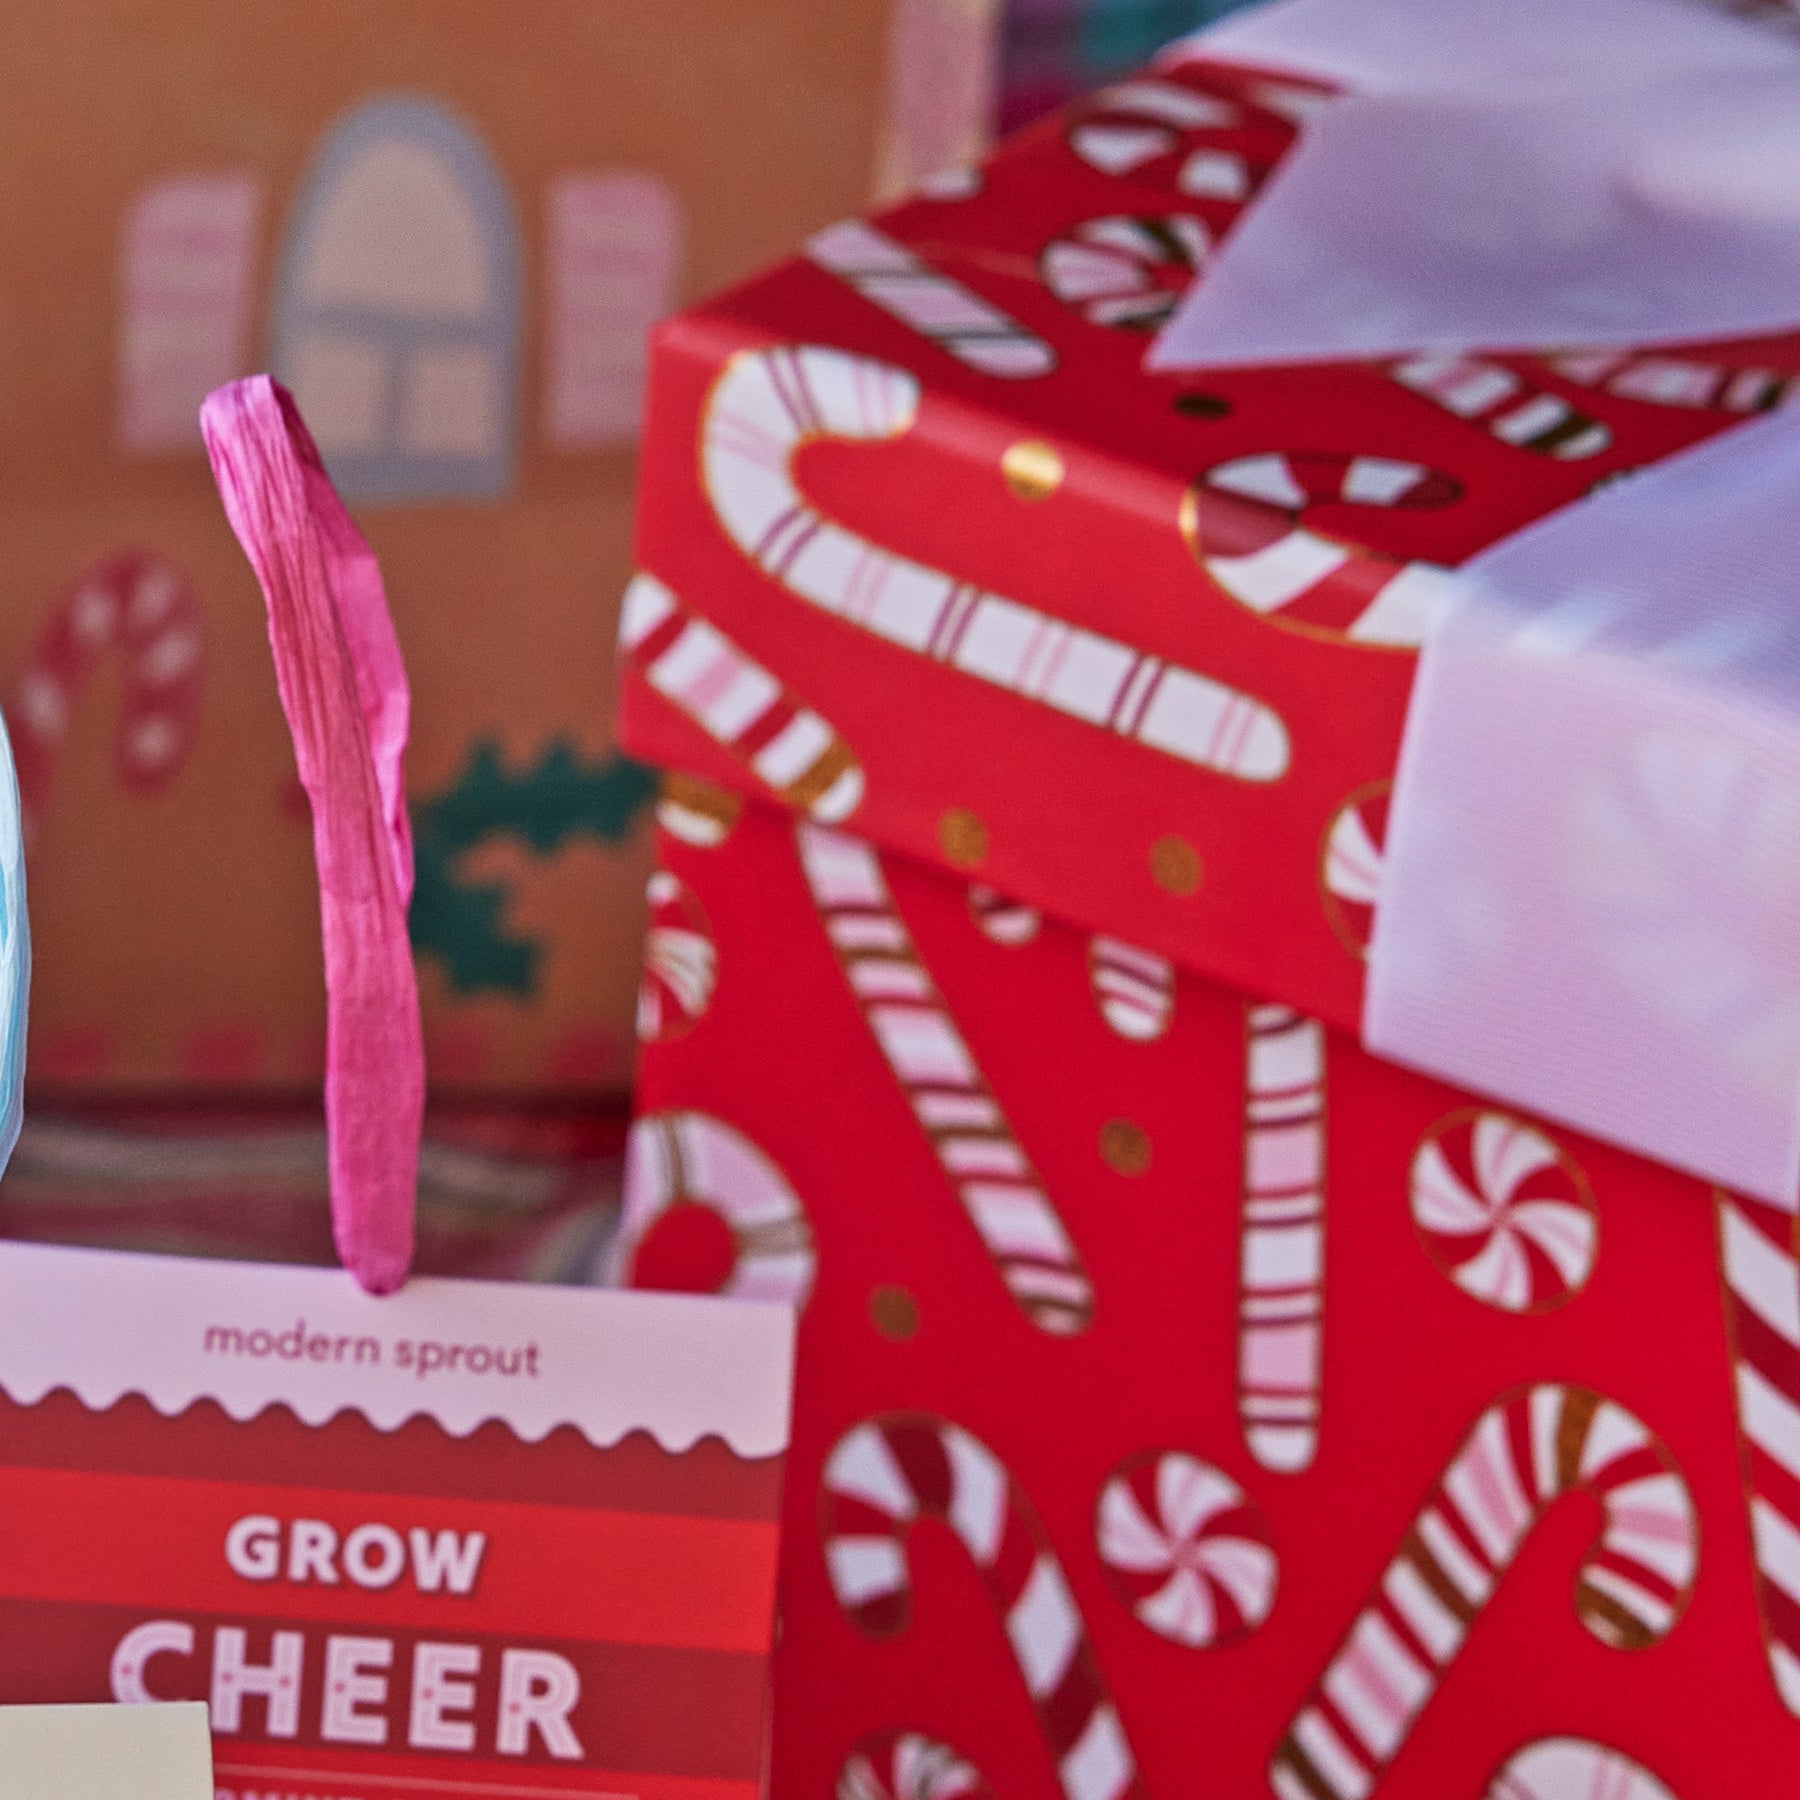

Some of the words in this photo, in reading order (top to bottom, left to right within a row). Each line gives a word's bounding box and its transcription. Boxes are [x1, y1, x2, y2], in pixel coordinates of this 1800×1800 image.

[203, 1318, 382, 1367] modern
[393, 1340, 541, 1380] sprout
[224, 1514, 486, 1595] GROW
[110, 1621, 585, 1760] CHEER
